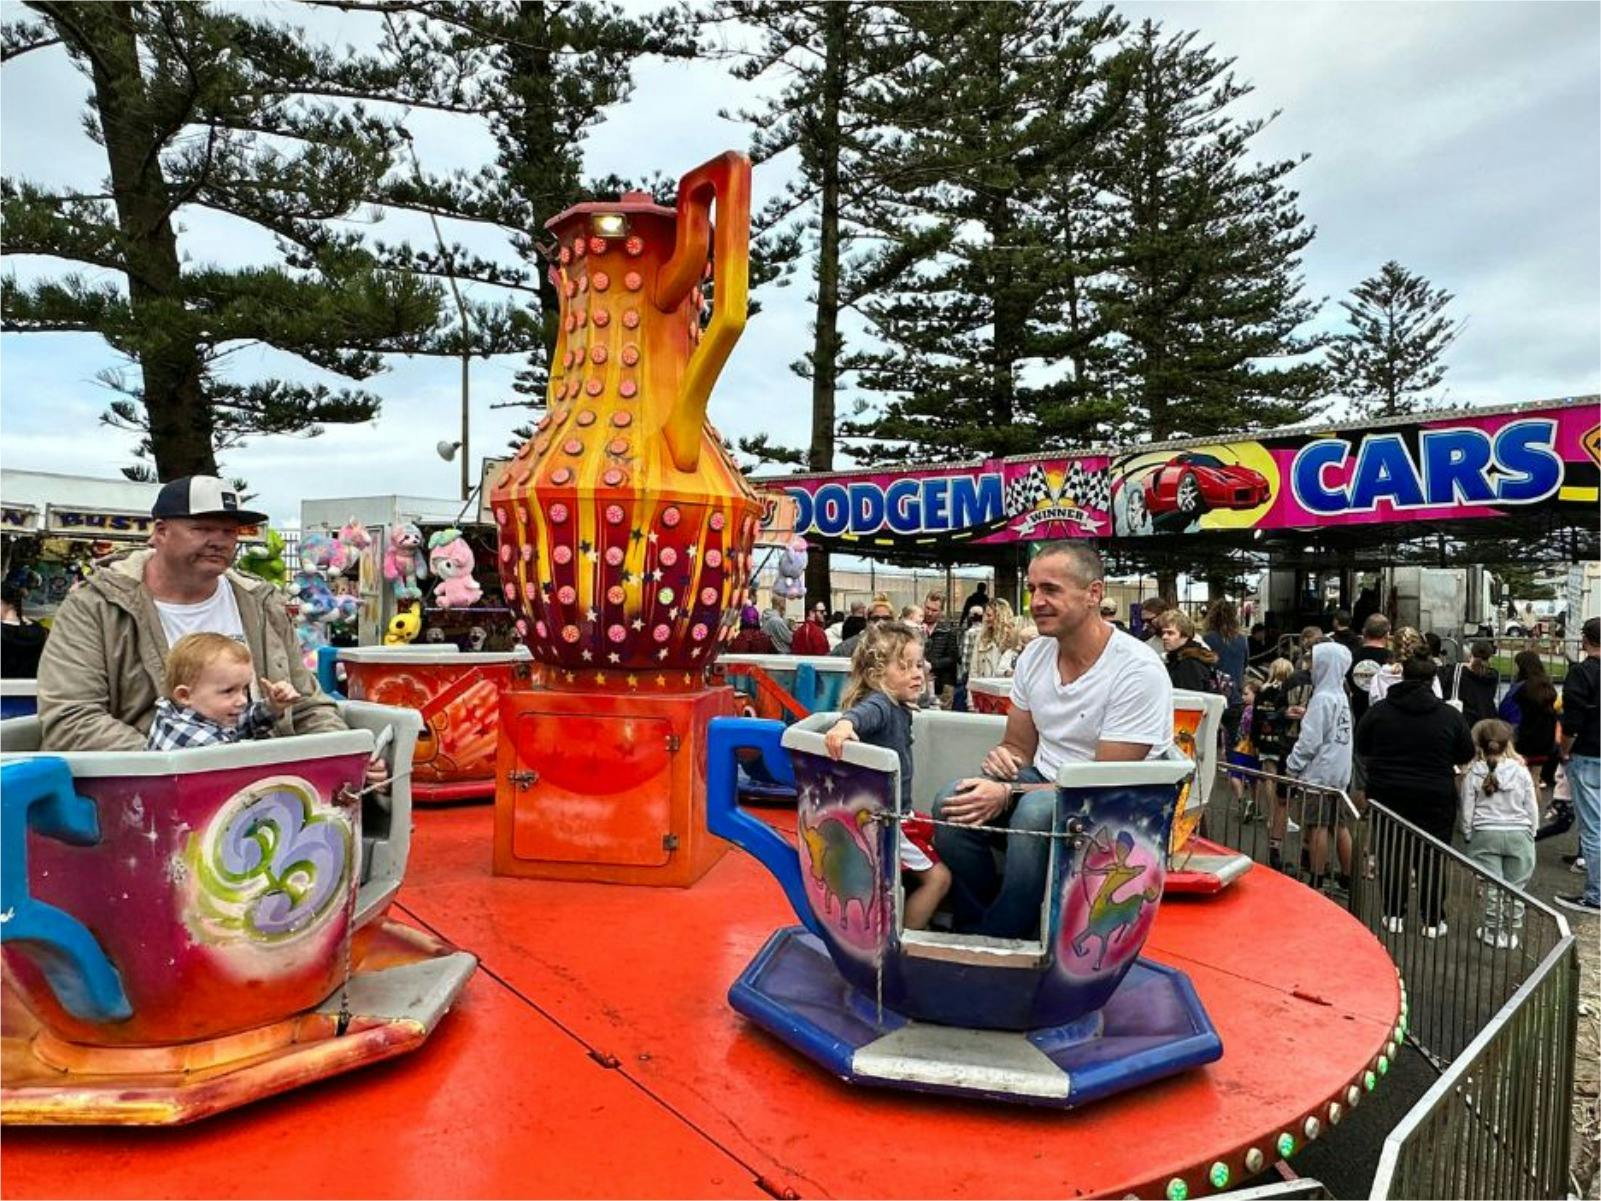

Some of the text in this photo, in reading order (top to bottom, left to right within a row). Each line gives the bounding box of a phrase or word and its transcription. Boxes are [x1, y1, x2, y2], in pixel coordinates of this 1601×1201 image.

[784, 418, 1565, 537] DODGEM CARS
[1029, 507, 1085, 523] WINNER
